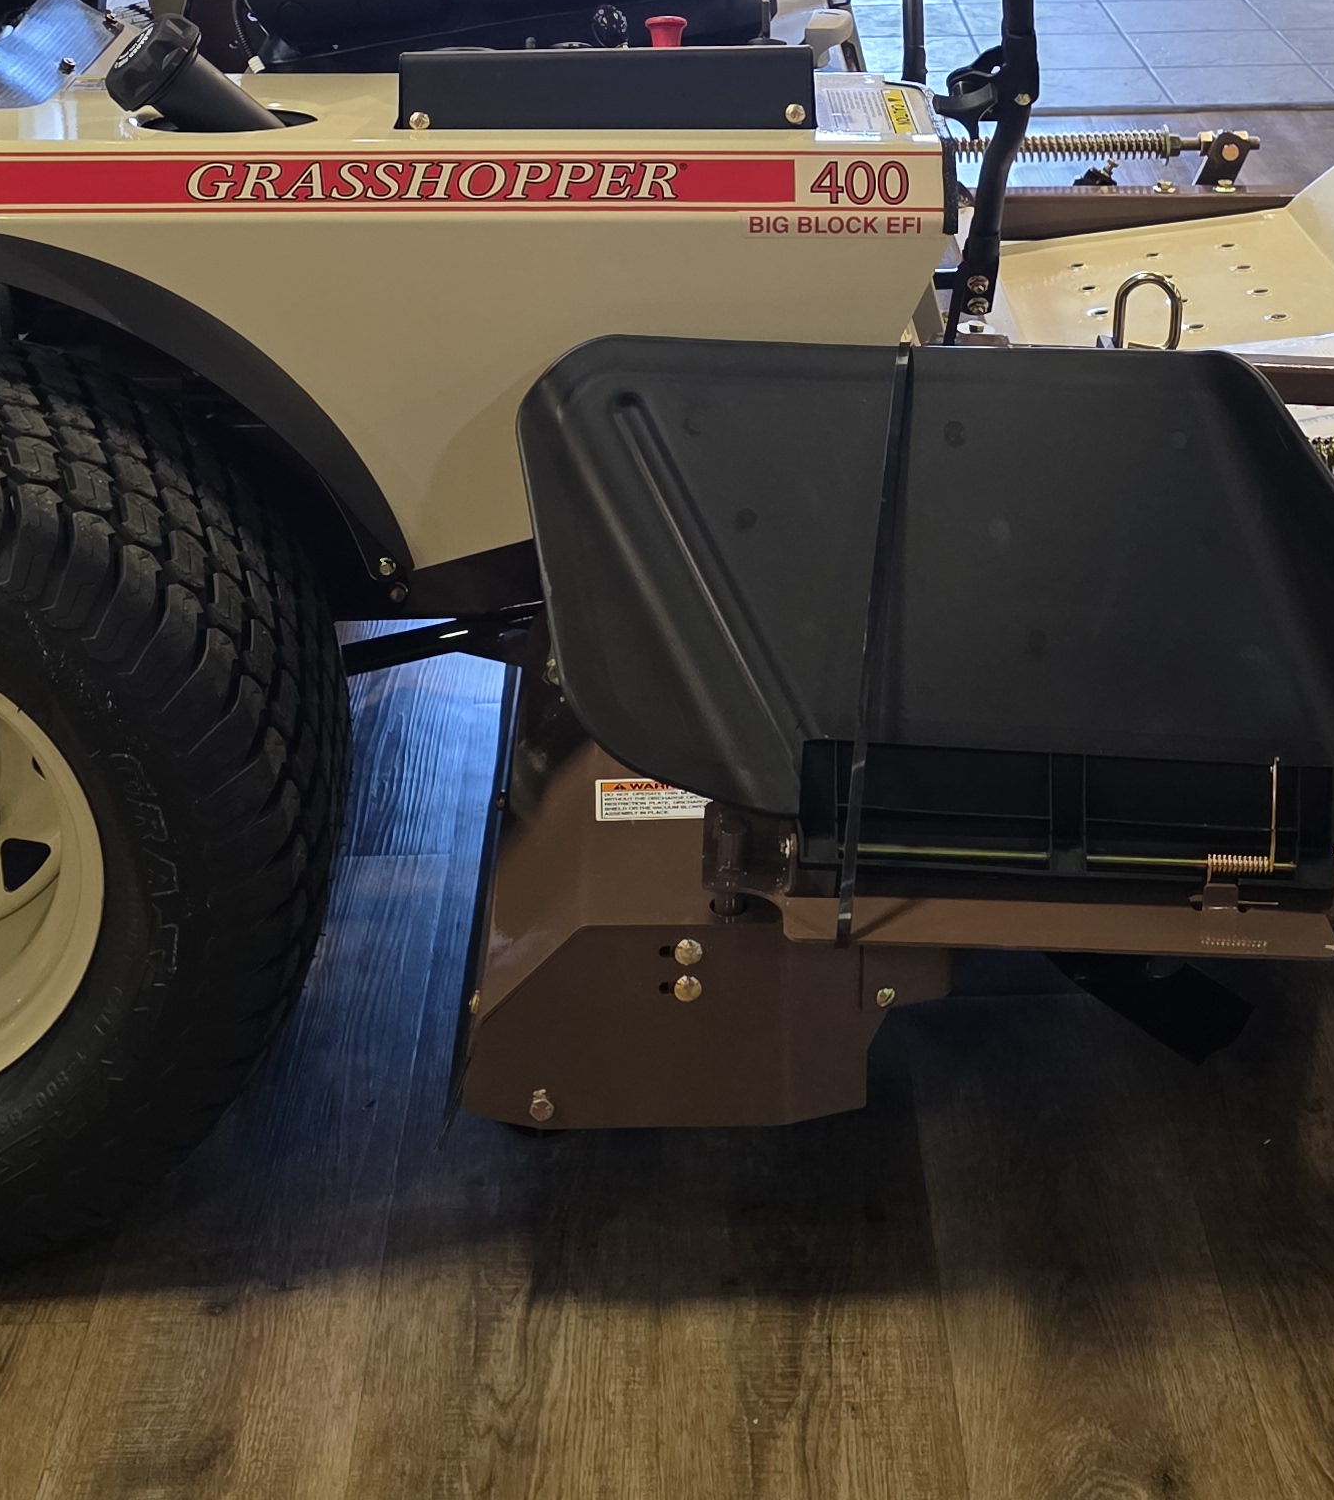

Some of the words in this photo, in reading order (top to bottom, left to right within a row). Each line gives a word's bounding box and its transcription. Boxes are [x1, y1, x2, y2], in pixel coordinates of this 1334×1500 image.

[810, 160, 910, 206] 400
[749, 216, 789, 234] BIG
[797, 216, 879, 234] BLOCK
[886, 217, 922, 234] EFI
